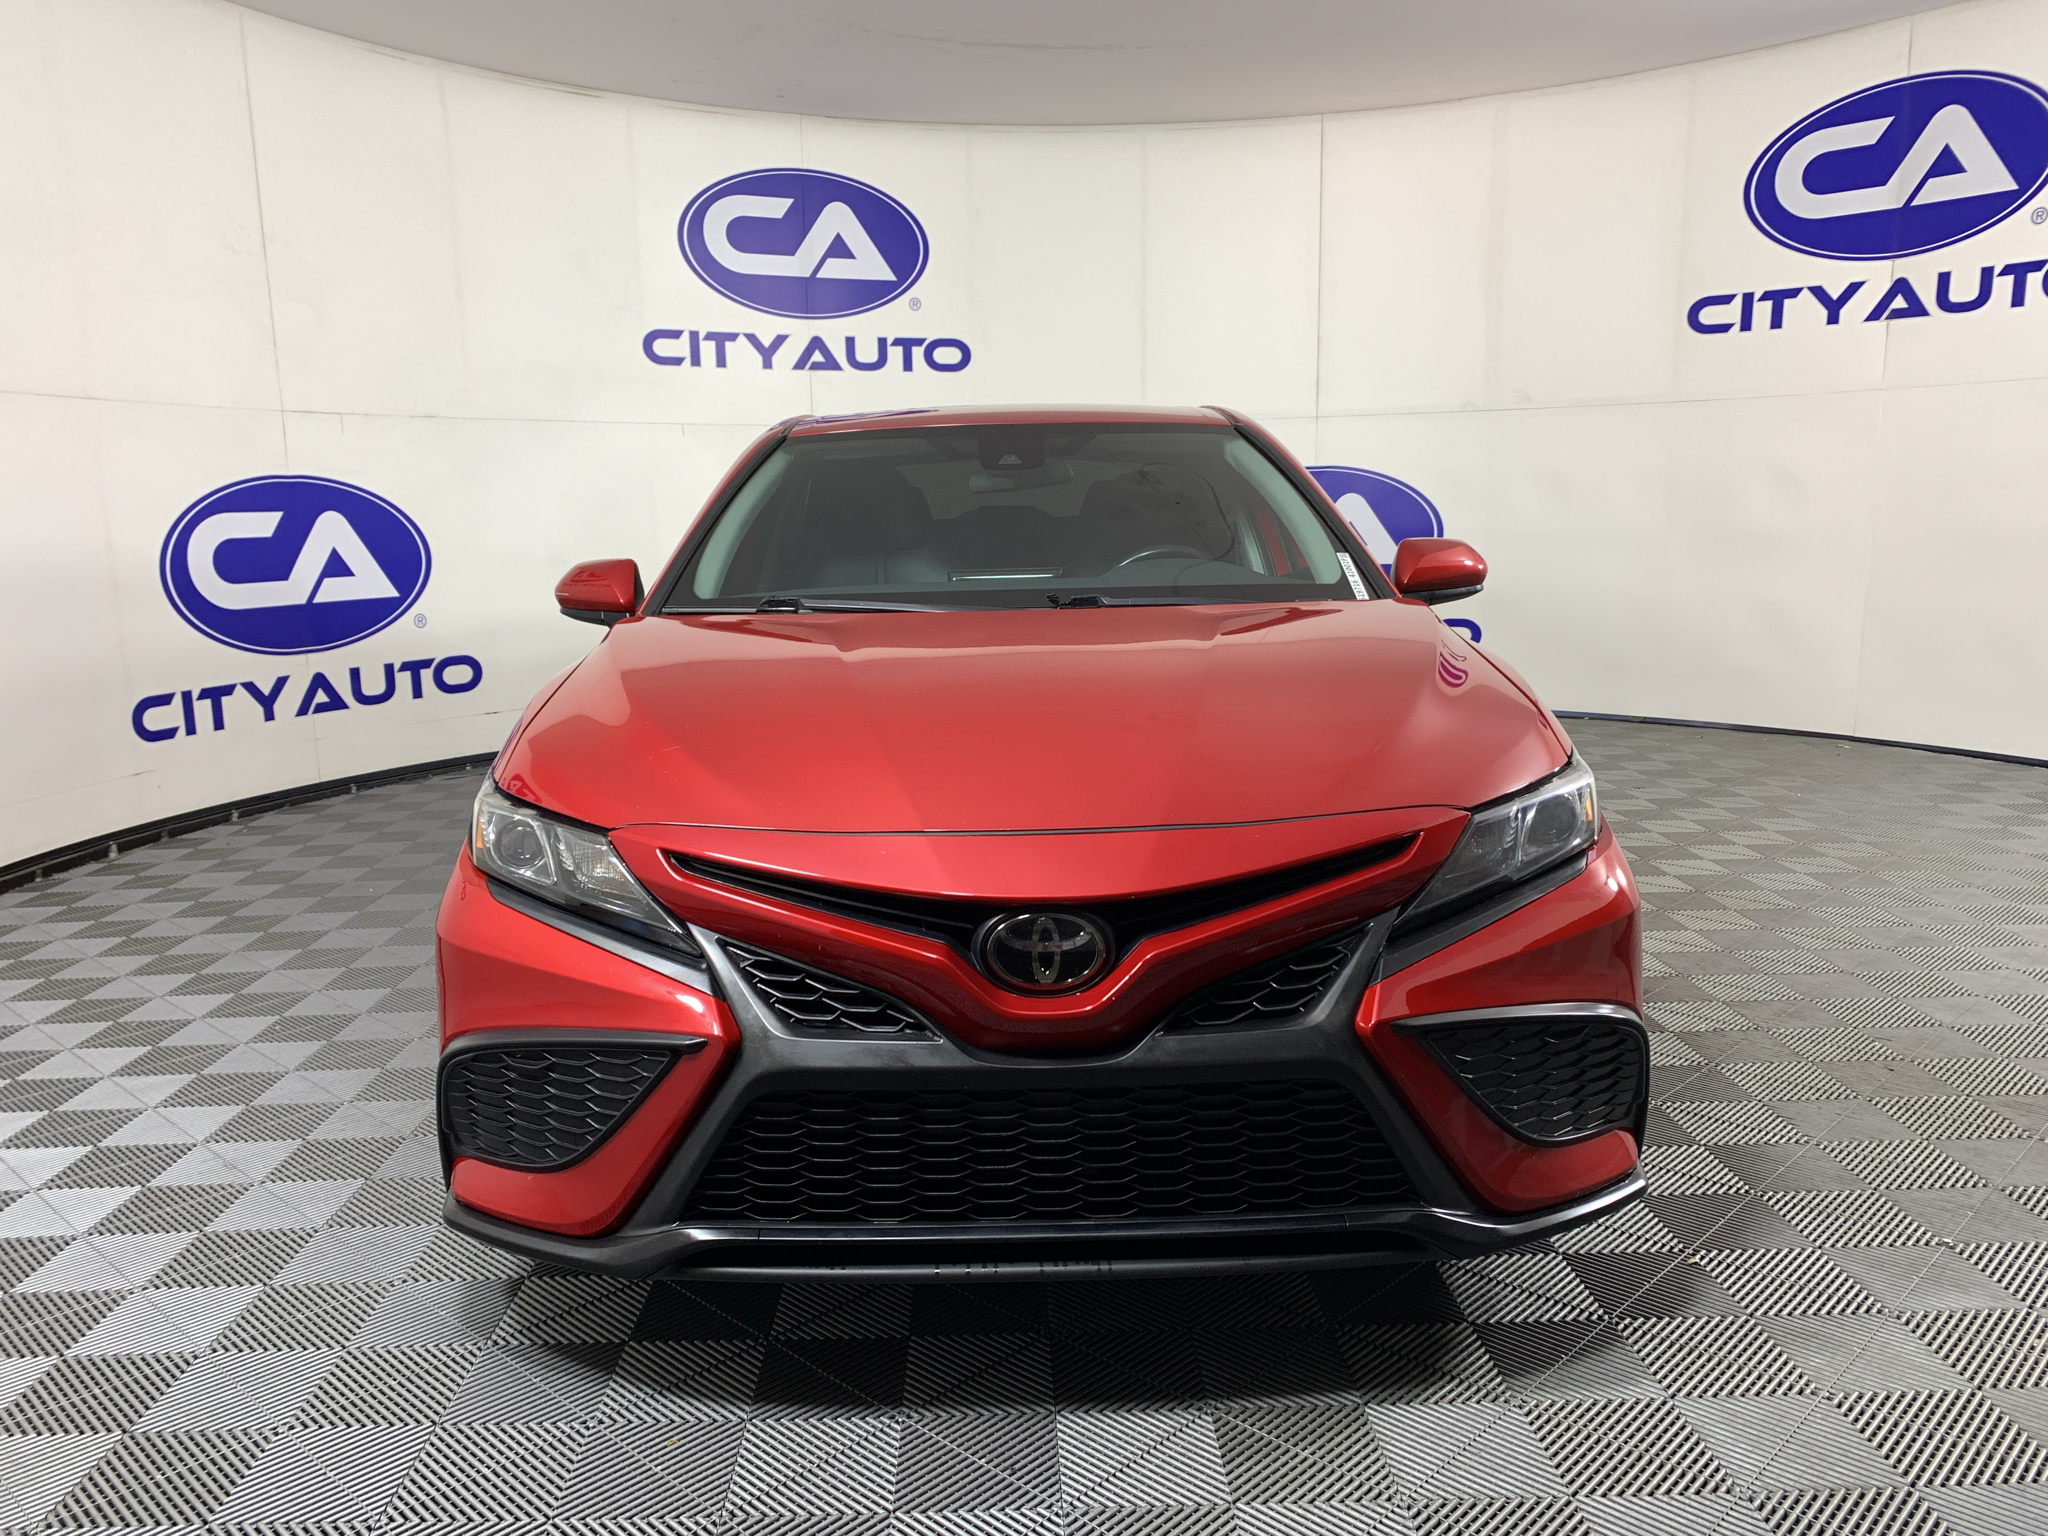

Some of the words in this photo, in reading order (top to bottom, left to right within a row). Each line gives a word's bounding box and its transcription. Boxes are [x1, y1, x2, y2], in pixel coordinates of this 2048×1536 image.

[1775, 104, 2019, 219] CA
[703, 195, 898, 281] CA
[1863, 259, 2048, 322] AUT
[187, 510, 400, 610] CA
